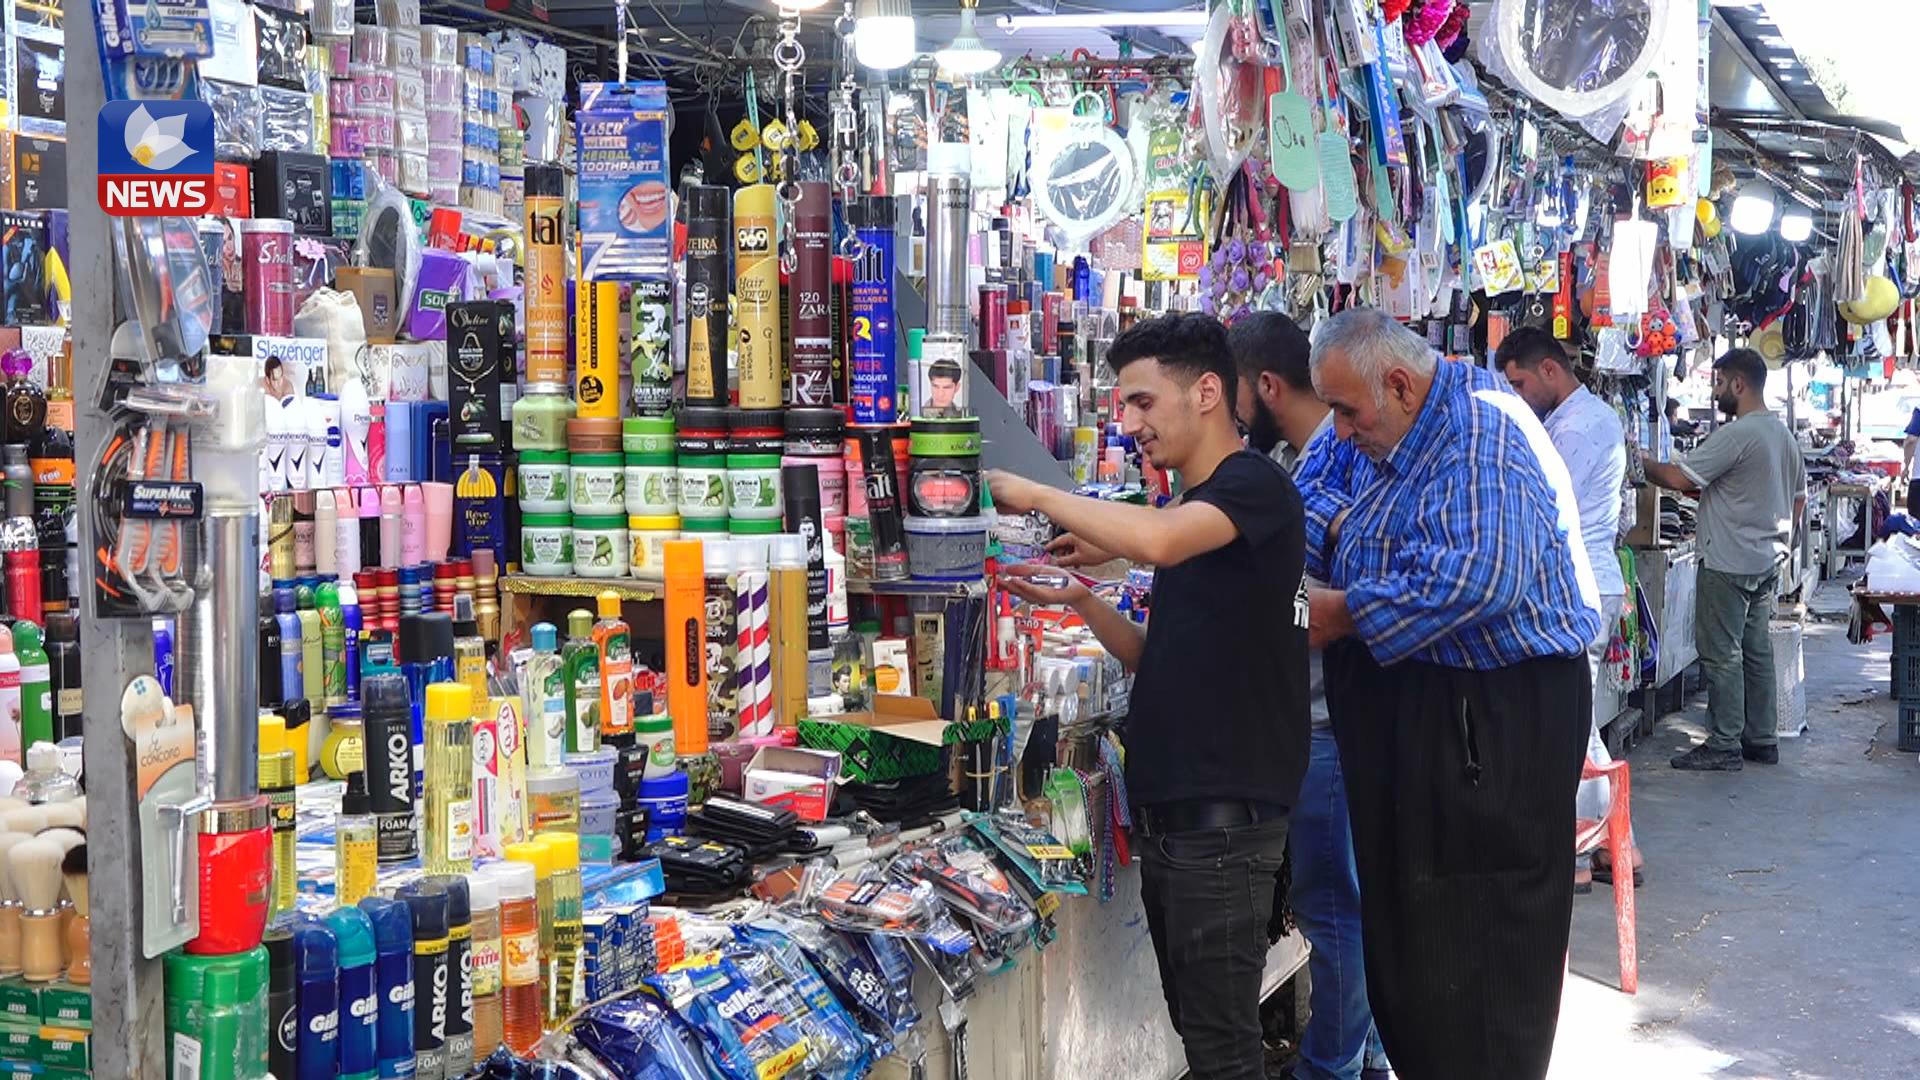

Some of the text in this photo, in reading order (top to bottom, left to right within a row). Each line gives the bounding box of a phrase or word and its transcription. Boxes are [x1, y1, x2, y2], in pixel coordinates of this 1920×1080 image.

[580, 121, 624, 136] LASER
[582, 150, 632, 161] HERBAL
[4, 217, 43, 228] SILVER
[739, 276, 764, 290] Hair
[740, 289, 772, 304] Spray
[255, 339, 326, 366] Slazenger
[688, 621, 697, 683] MY ROYAL
[387, 725, 406, 733] MEN
[387, 734, 410, 803] ARKO
[379, 819, 408, 830] FOAM
[431, 964, 448, 1041] ARKO
[9, 1033, 30, 1044] DERBY
